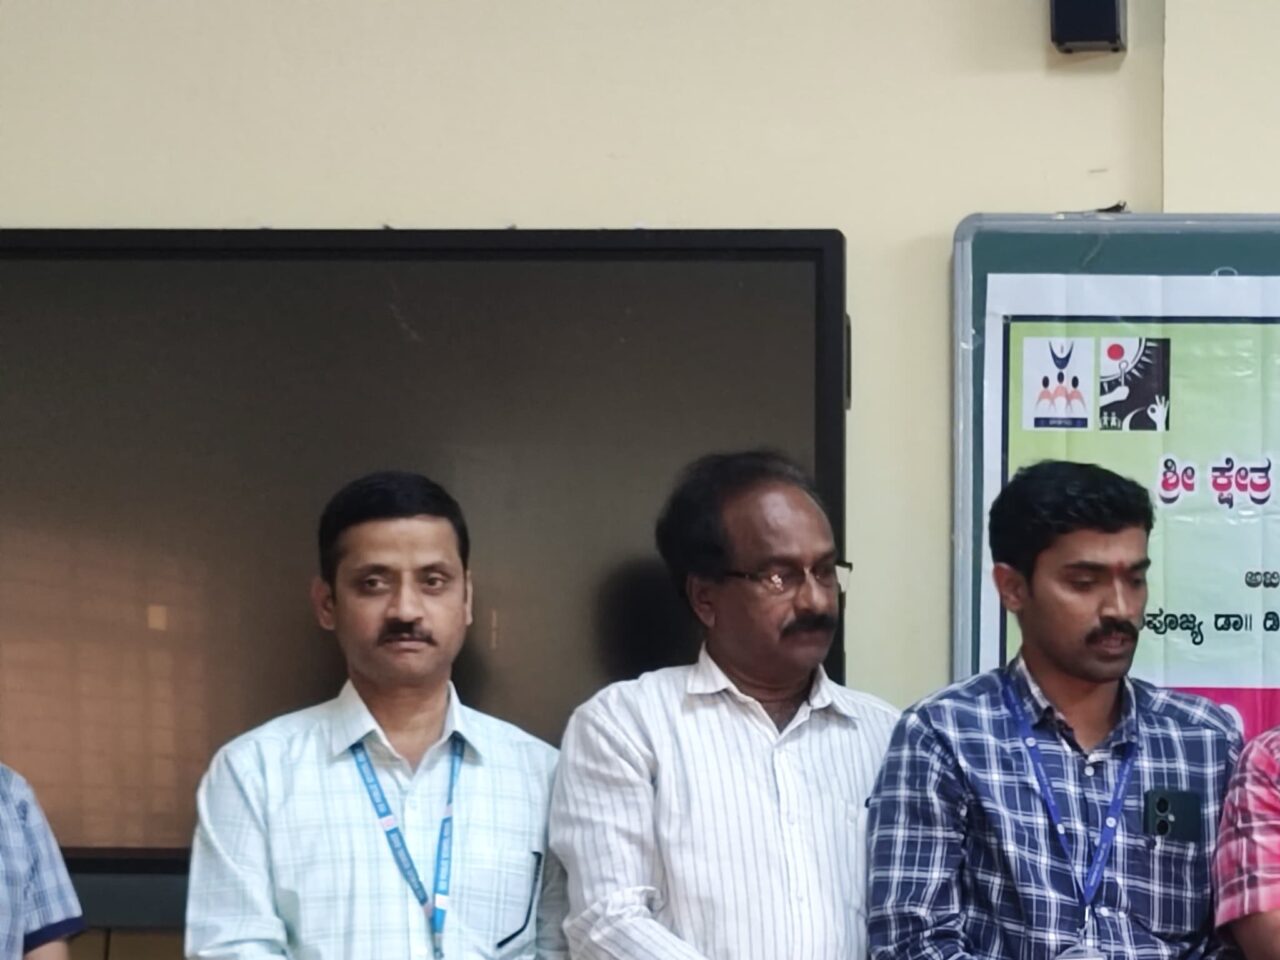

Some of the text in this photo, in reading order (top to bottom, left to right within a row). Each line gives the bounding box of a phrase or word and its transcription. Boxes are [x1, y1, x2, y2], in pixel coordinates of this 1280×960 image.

[1159, 458, 1195, 504] ಶ್ರೀ
[1211, 457, 1271, 509] ಕ್ಷೇತ್ರ
[1141, 607, 1205, 645] ಪೂಜ್ಯ
